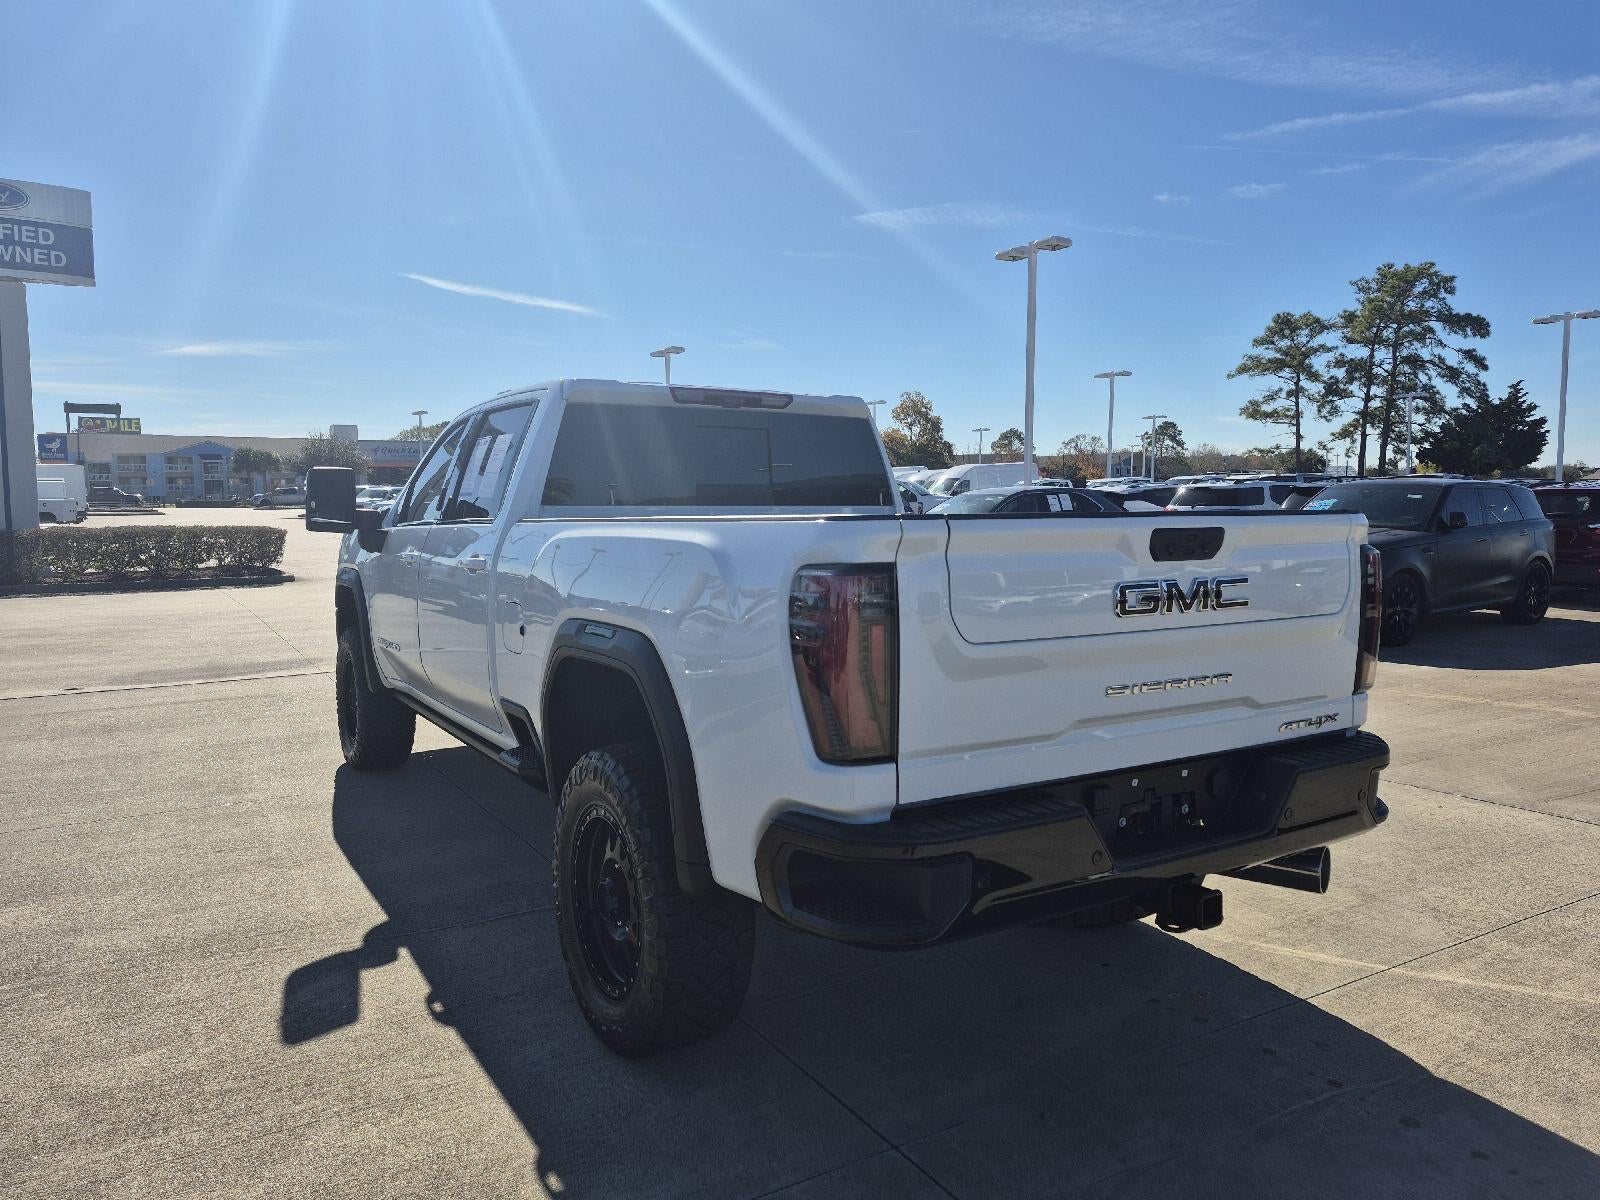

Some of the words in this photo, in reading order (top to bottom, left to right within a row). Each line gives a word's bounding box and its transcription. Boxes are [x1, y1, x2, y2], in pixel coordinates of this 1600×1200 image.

[0, 223, 55, 245] FIED
[1113, 575, 1249, 617] GMC
[1105, 672, 1233, 697] SIERRA
[1278, 712, 1340, 732] AT4X
